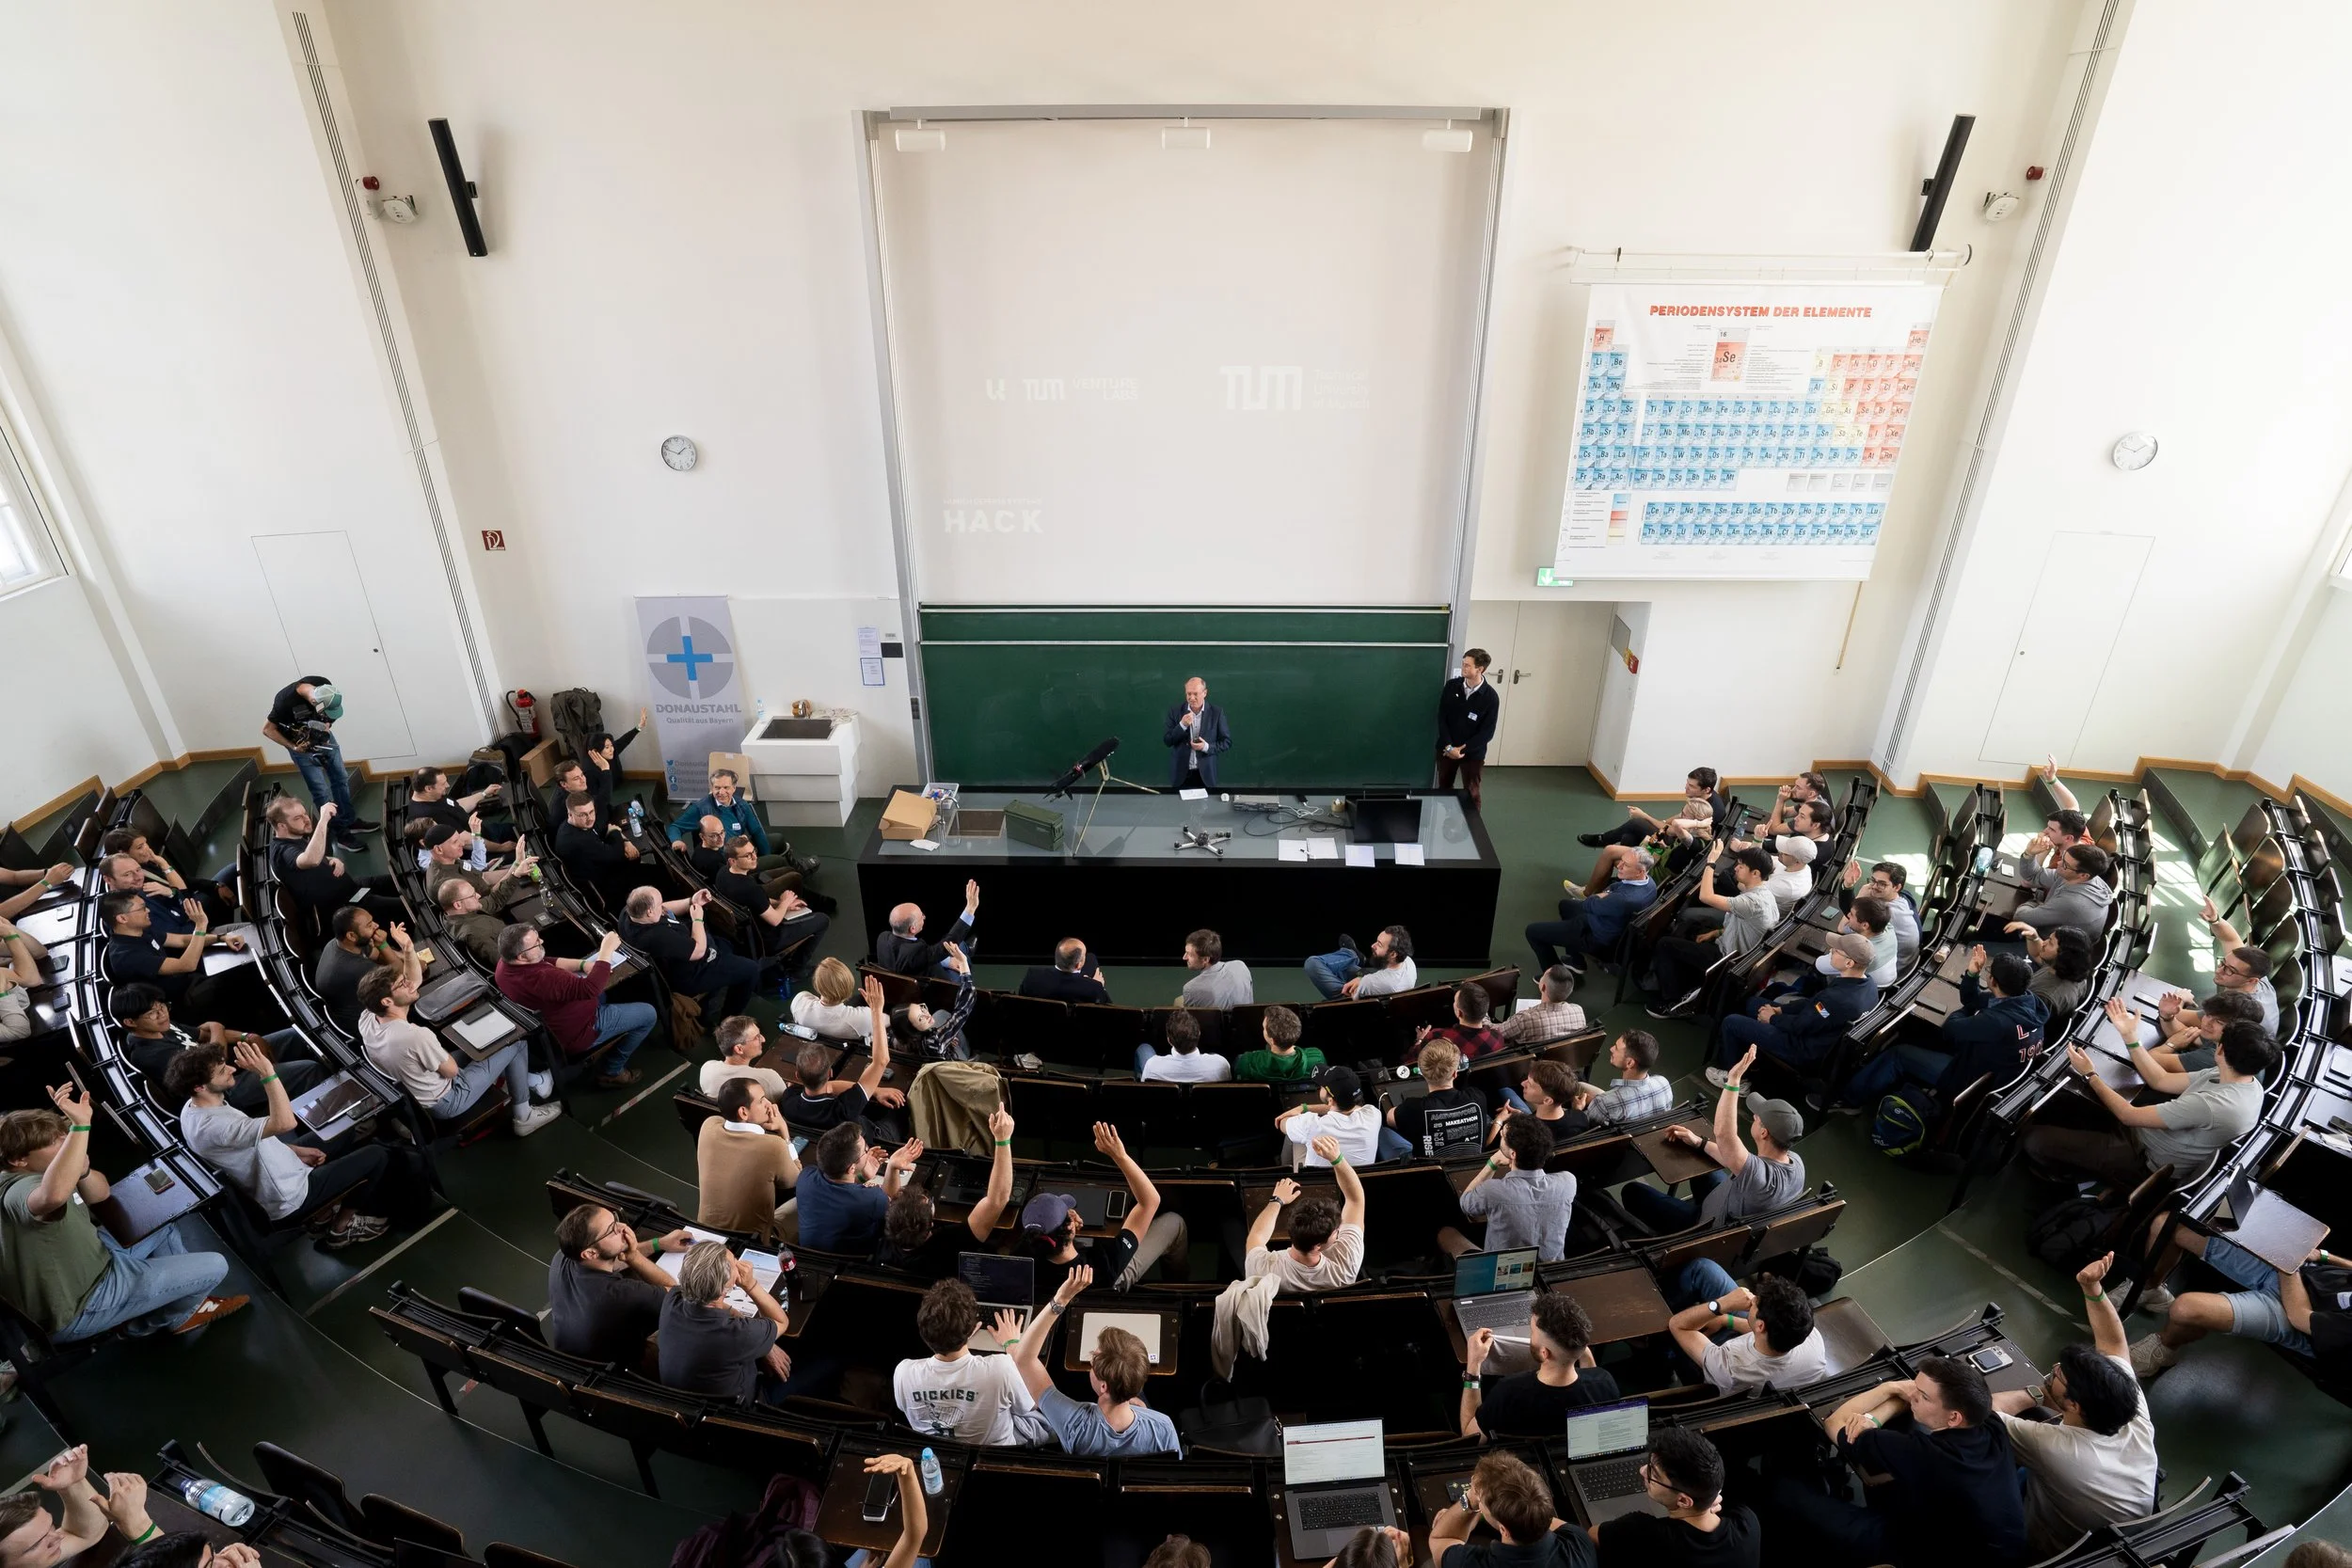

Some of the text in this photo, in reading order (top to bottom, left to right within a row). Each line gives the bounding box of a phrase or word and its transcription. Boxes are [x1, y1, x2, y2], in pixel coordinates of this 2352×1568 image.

[1650, 305, 1872, 317] PERIODENSYSTEM DER ELEMENTE
[1722, 352, 1736, 363] Se
[1022, 378, 1065, 400] TUM
[1073, 378, 1139, 389] VENTURE
[1219, 366, 1303, 411] TUM
[1610, 382, 1620, 391] Mg
[1104, 390, 1138, 401] LABS
[943, 509, 1044, 533] HACK
[656, 704, 742, 713] DONAUSTAHL
[1445, 1115, 1478, 1126] MAKEATHON
[1423, 1136, 1434, 1156] RISE
[912, 1389, 975, 1402] DICKIES
